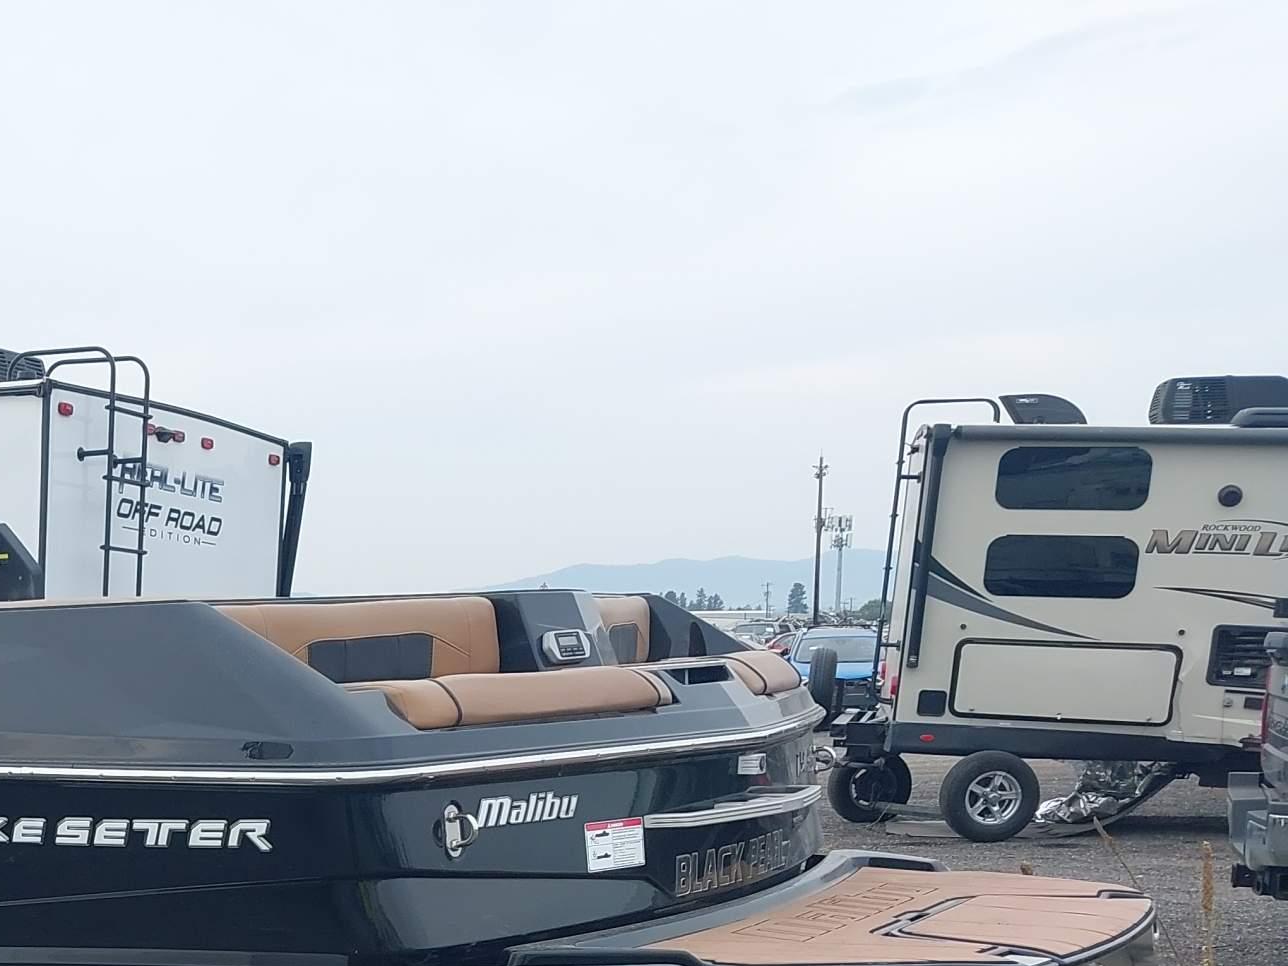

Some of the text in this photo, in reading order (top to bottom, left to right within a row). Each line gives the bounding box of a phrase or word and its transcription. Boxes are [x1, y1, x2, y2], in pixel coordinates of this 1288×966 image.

[116, 498, 222, 536] OFF ROAD
[1202, 524, 1261, 532] ROCKWOOD
[1145, 530, 1251, 554] MINI
[477, 788, 579, 828] Malibu
[55, 817, 273, 852] SETTER
[675, 842, 745, 898] BLACK
